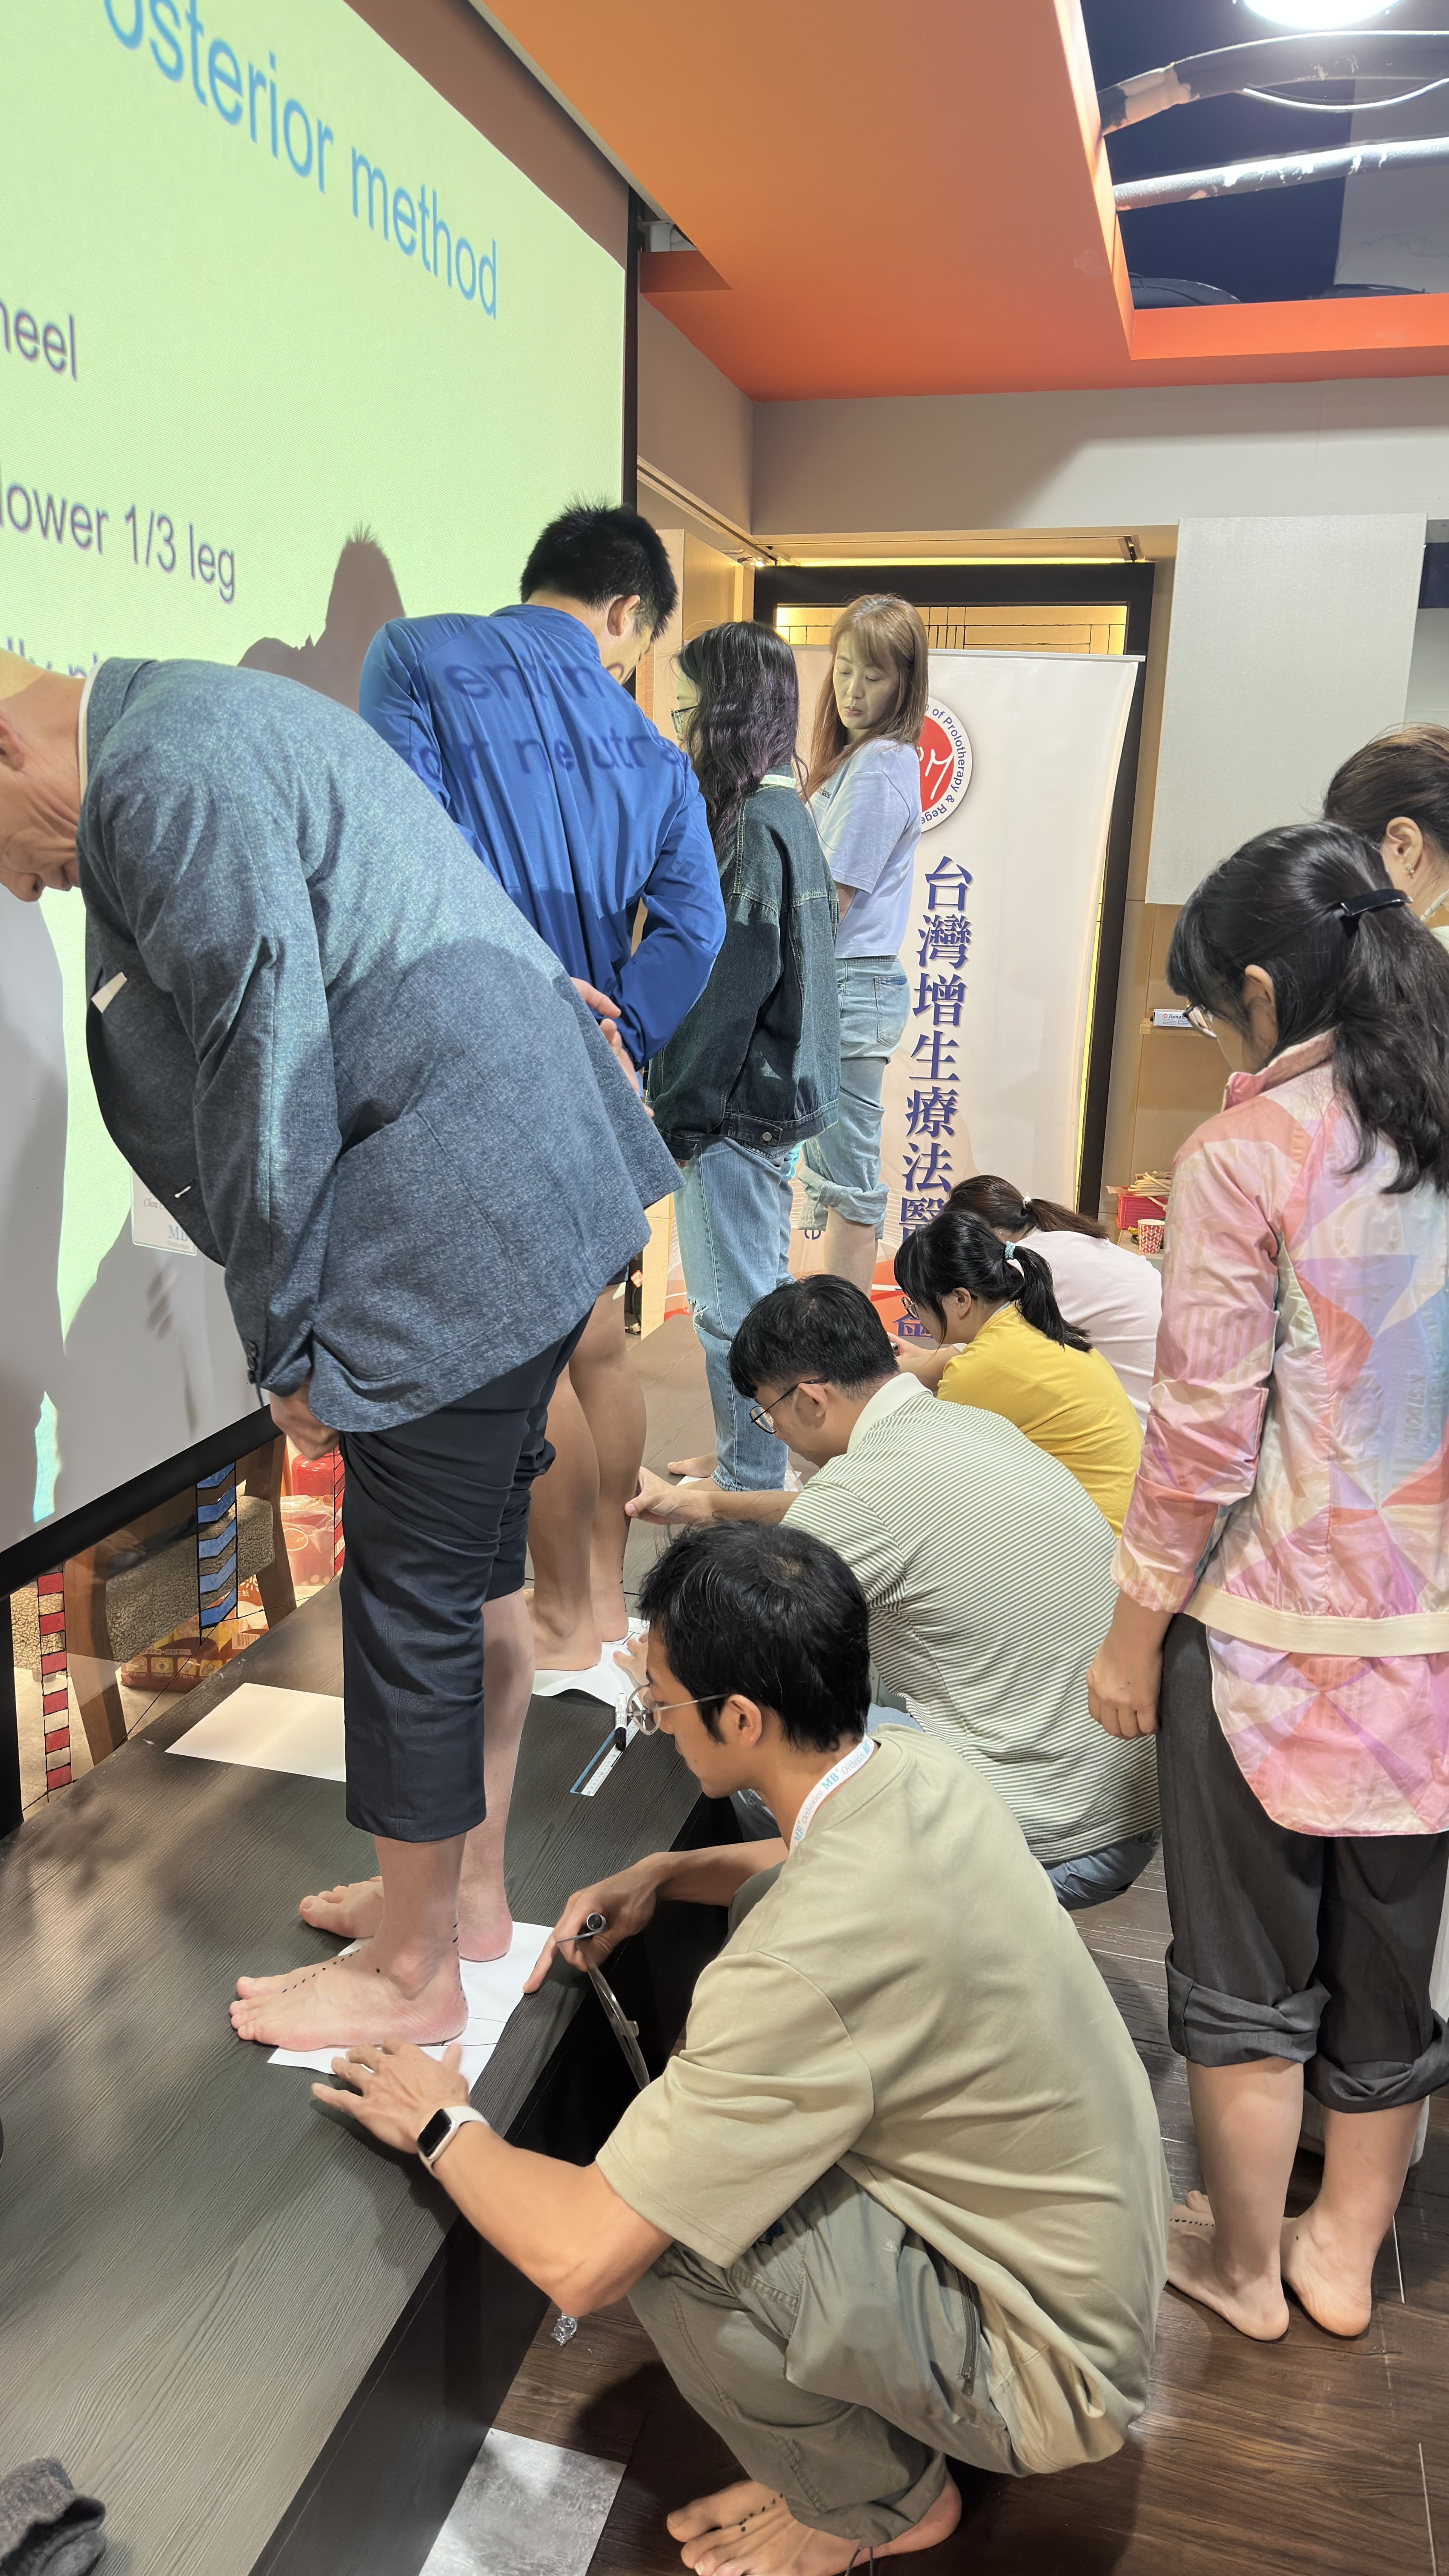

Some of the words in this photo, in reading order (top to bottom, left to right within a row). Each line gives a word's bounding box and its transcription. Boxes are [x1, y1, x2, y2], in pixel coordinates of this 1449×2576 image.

[351, 145, 497, 321] method
[124, 503, 176, 574] 1/3
[189, 521, 235, 604] leg
[932, 708, 945, 719] of
[943, 717, 966, 793] Prolotherapy
[794, 1826, 804, 1842] MB
[802, 1790, 823, 1824] Orthotics
[821, 1772, 839, 1791] MB
